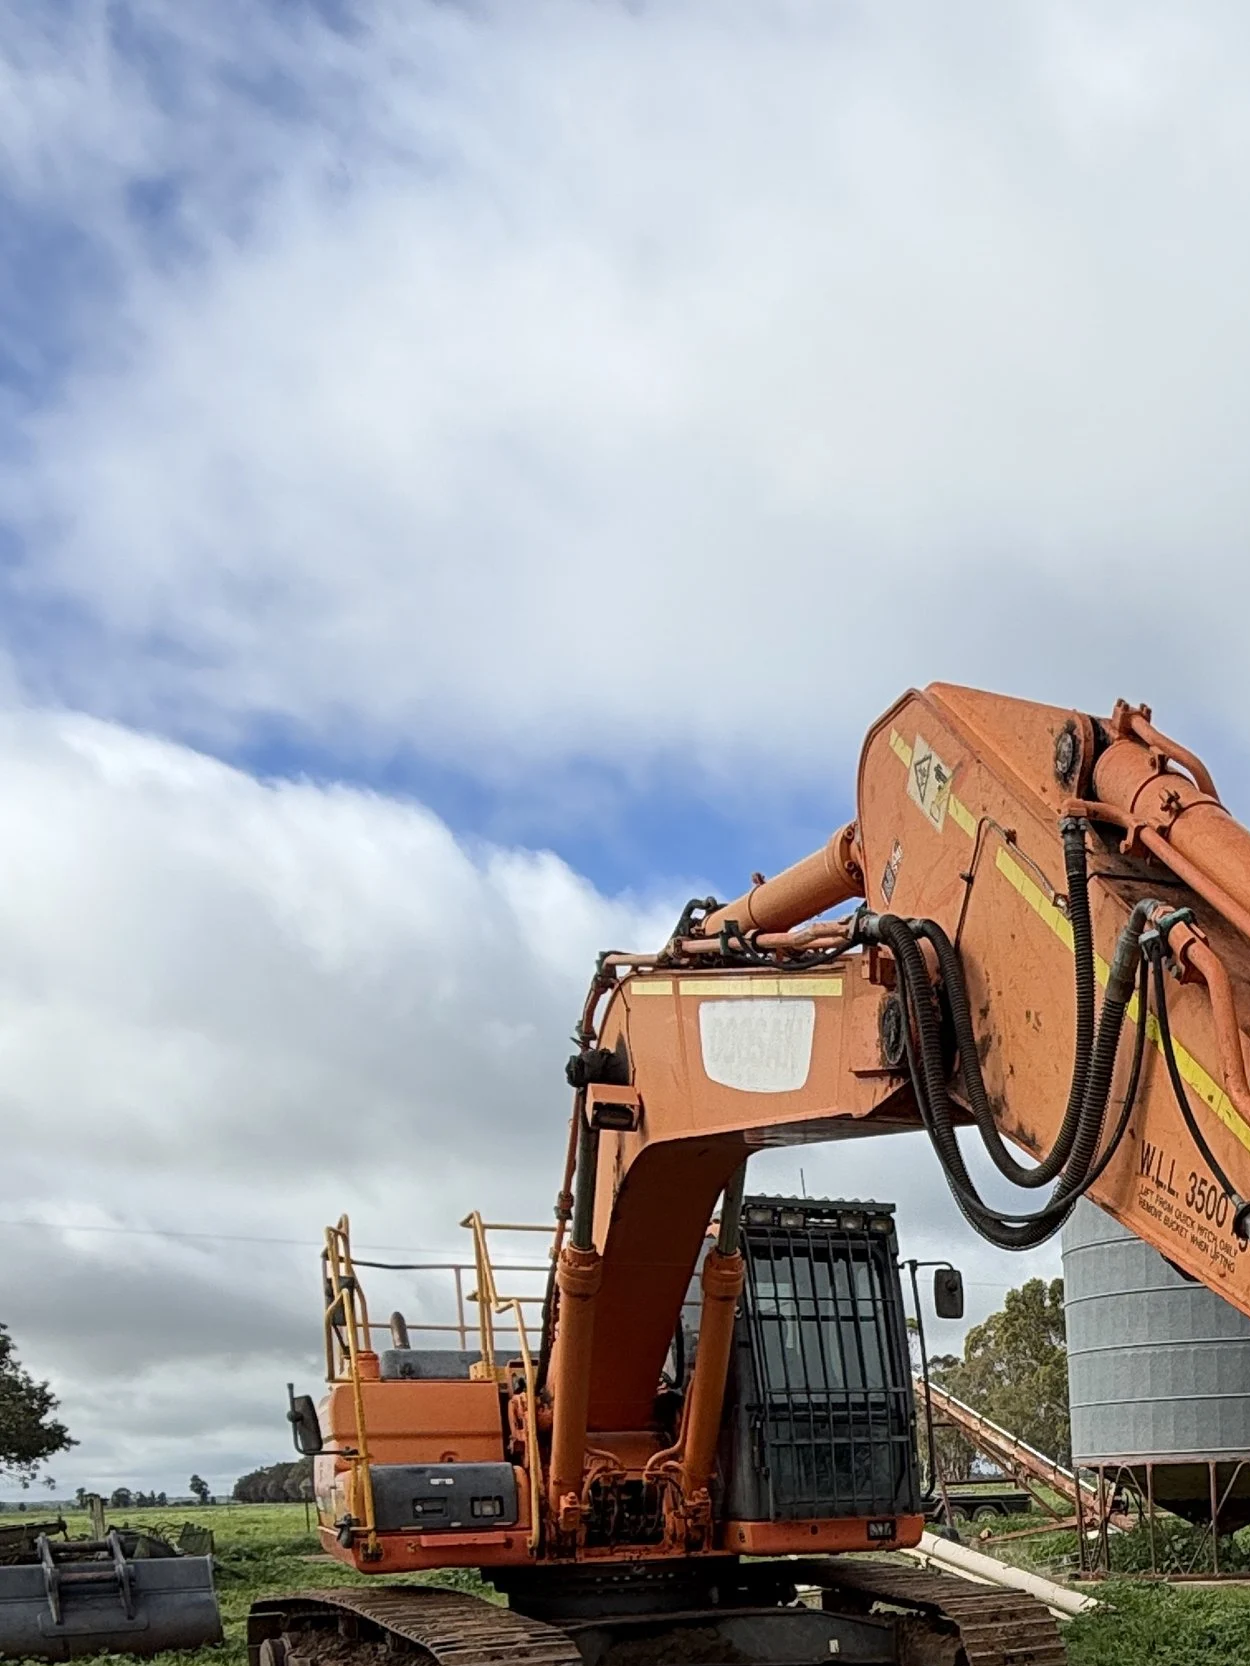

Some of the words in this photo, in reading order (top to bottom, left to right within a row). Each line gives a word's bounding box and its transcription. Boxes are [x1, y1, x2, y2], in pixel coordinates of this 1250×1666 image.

[1141, 1140, 1179, 1199] W.L.L.
[1185, 1171, 1228, 1228] 3500
[1155, 1193, 1174, 1213] FROM
[1174, 1208, 1195, 1229] QUICK
[1138, 1199, 1163, 1221] REMOVE
[1163, 1215, 1189, 1239] BUCKET
[1190, 1233, 1209, 1254] WHEN
